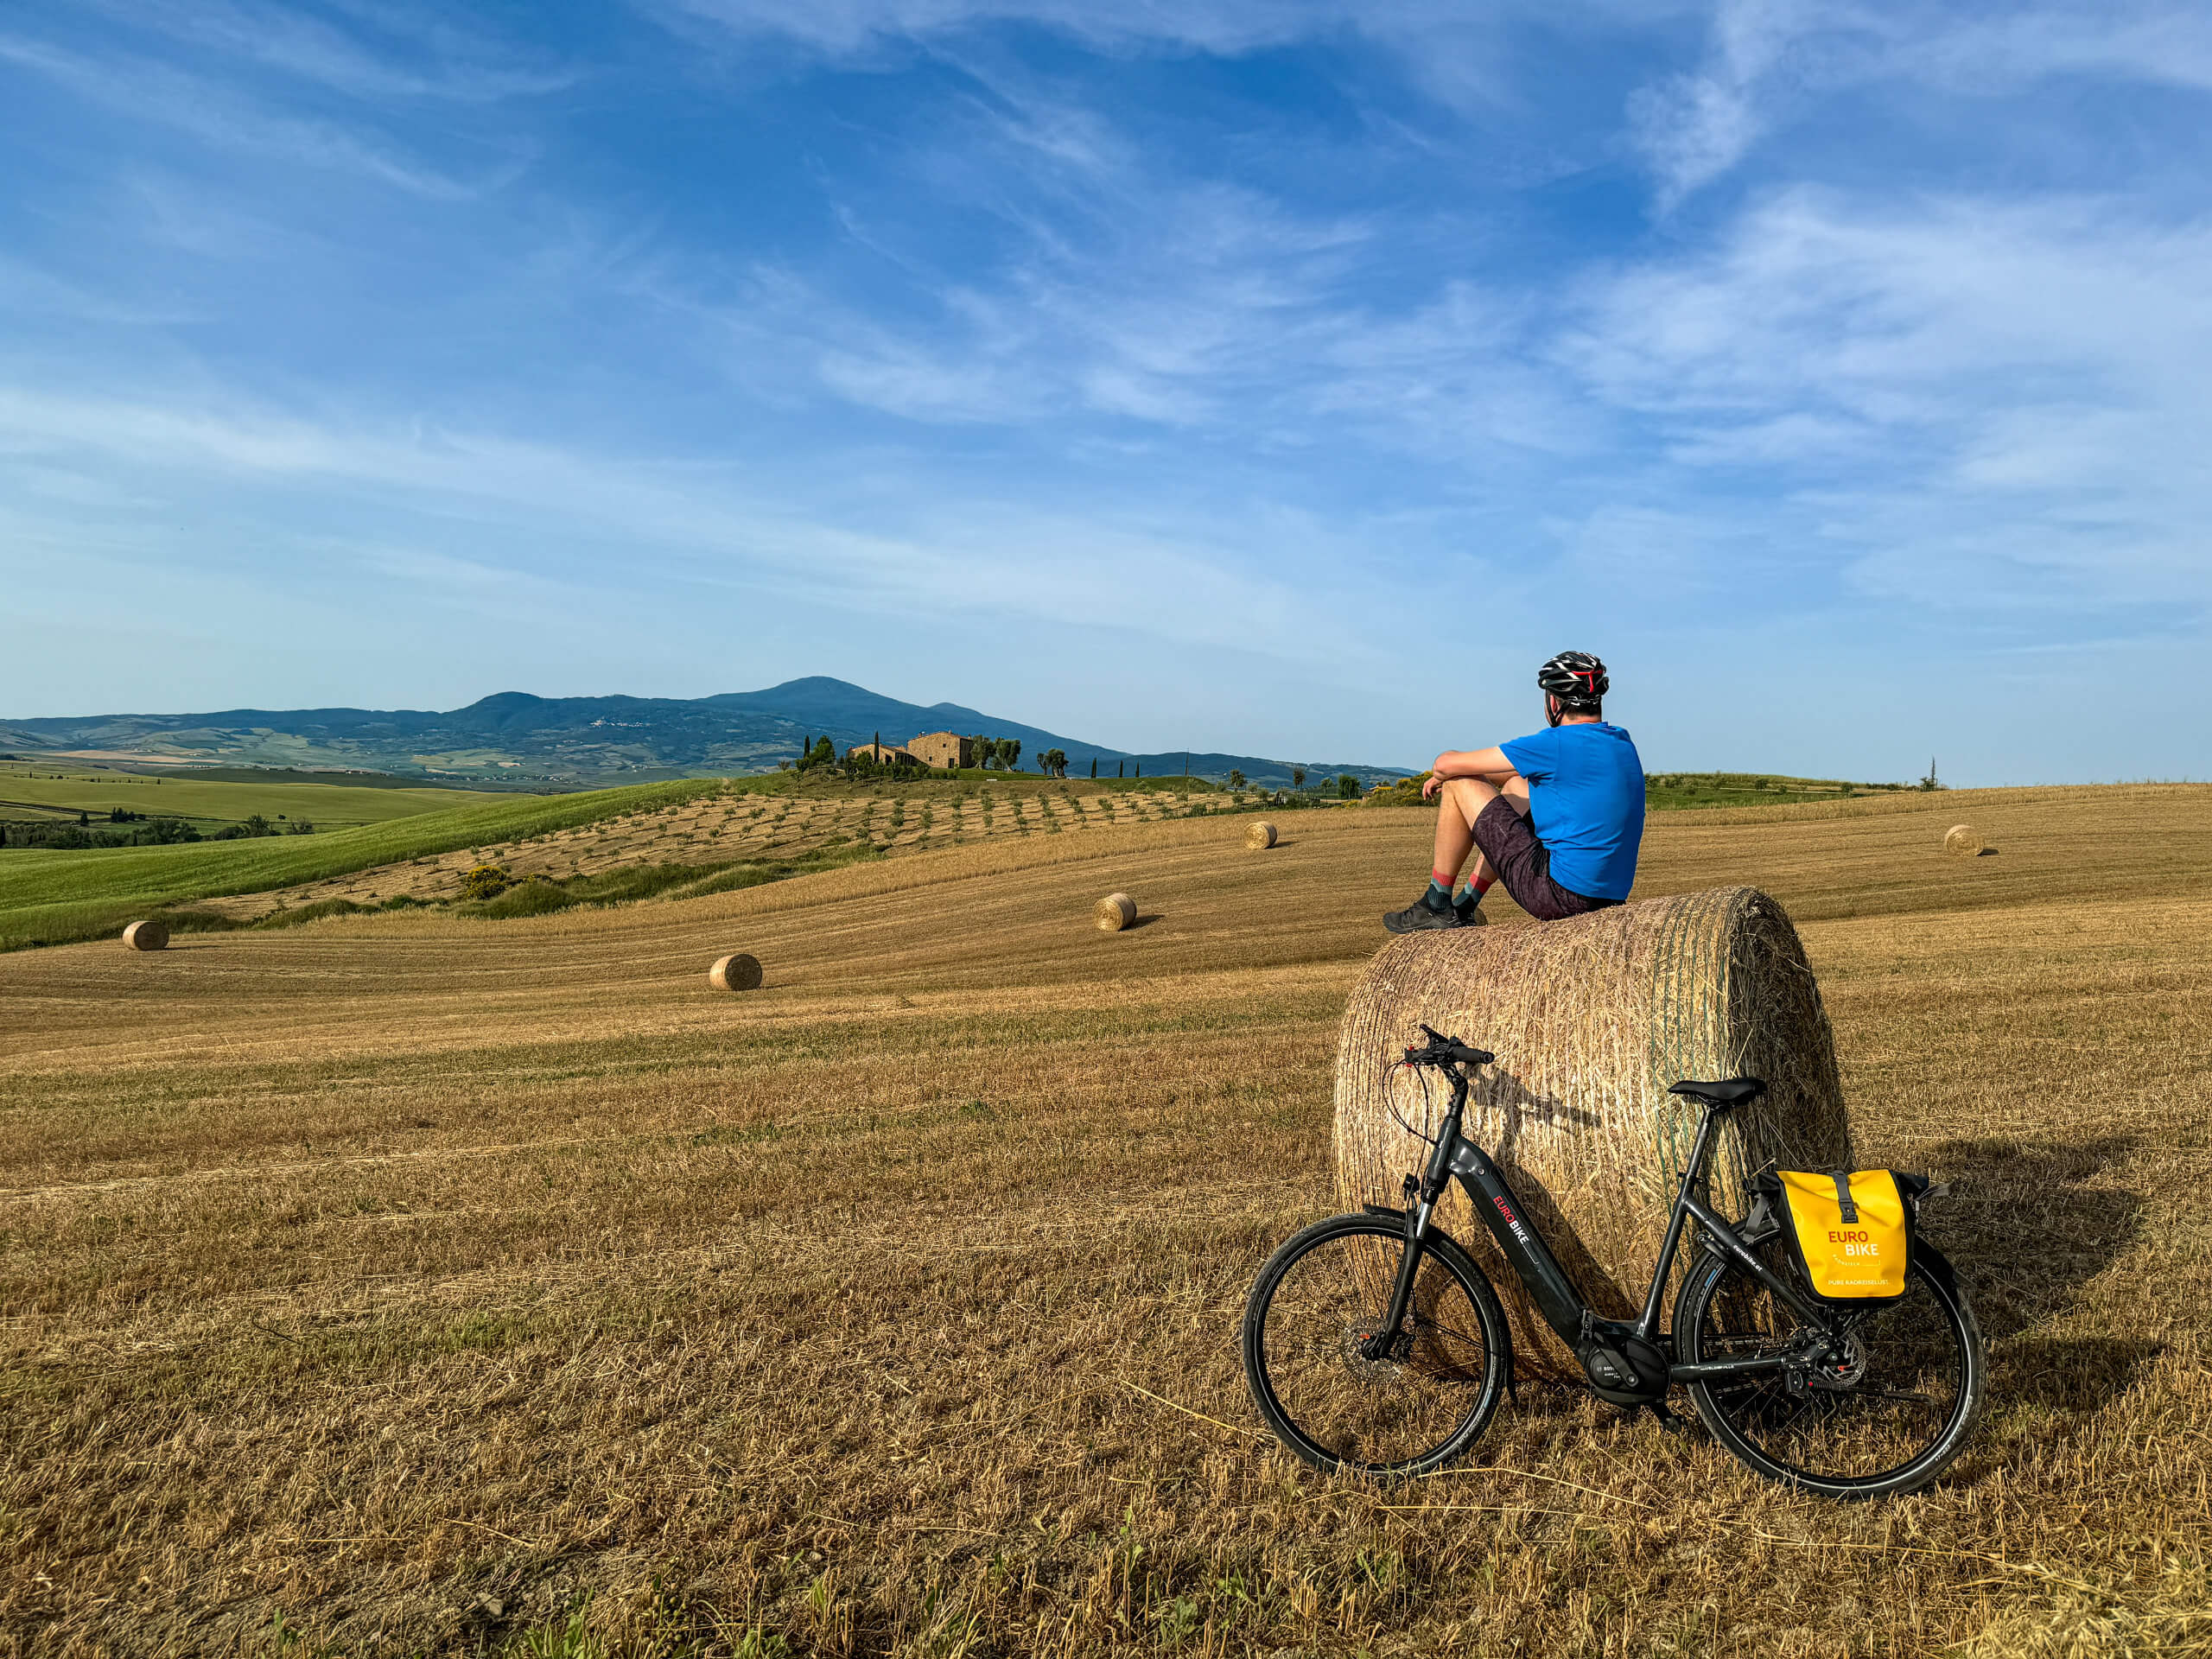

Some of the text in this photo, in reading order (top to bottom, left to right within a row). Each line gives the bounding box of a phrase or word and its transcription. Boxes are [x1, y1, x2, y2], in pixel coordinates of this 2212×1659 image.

[1493, 1195, 1529, 1244] EUROBIKE
[1828, 1230, 1868, 1243] EURO
[1732, 1244, 1763, 1272] eurobike.at
[1845, 1244, 1879, 1255] BIKE
